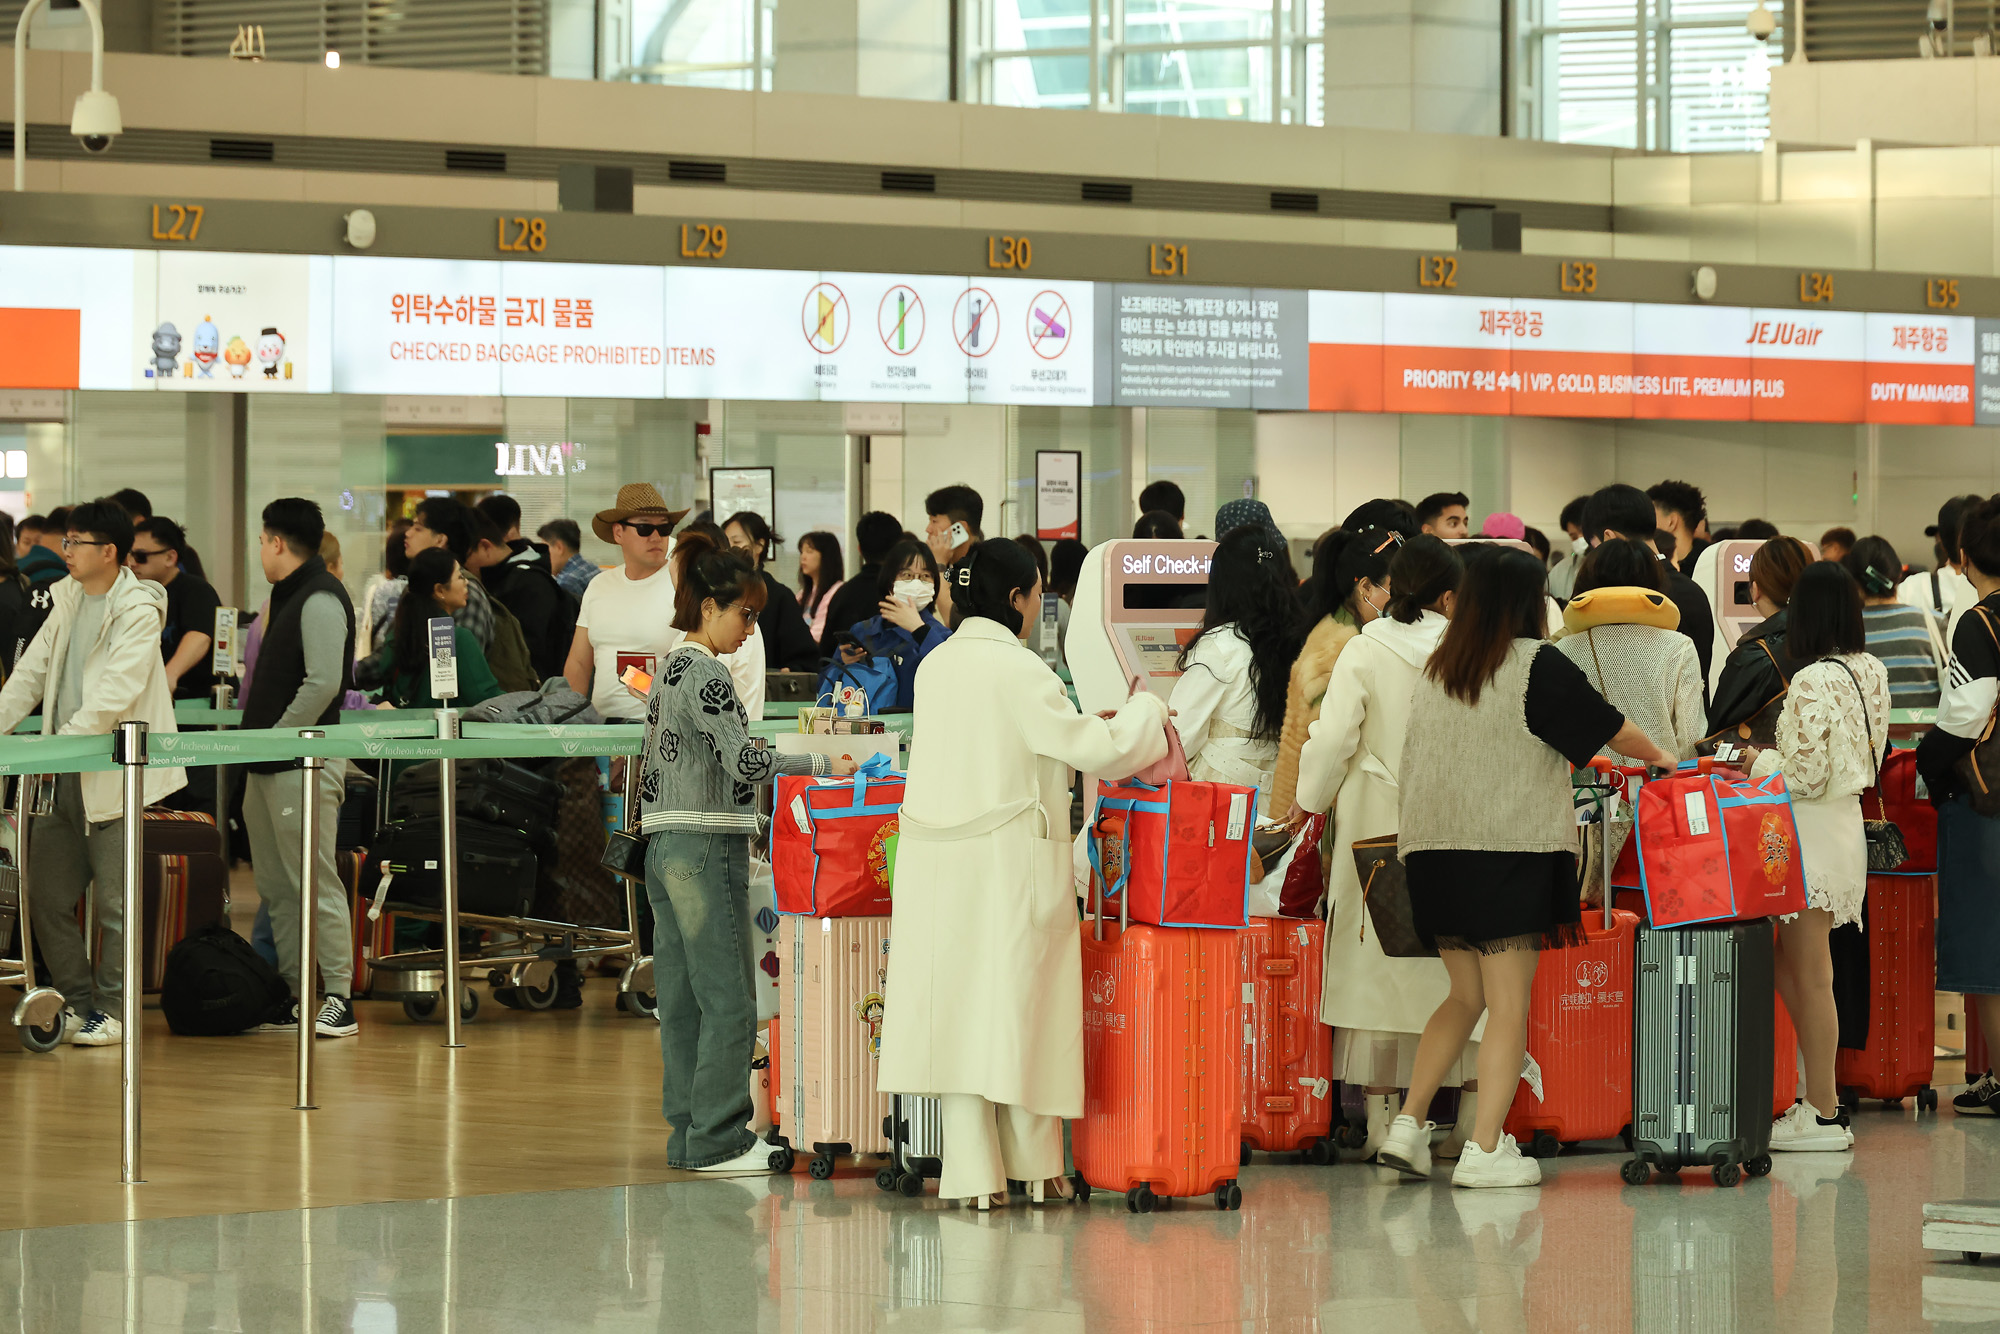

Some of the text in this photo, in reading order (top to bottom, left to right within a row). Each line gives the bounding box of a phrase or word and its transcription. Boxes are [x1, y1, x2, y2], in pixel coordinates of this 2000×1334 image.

[152, 203, 205, 241] L27
[498, 216, 547, 252] L28
[681, 223, 728, 259] L29
[988, 235, 1032, 270] L30
[1150, 243, 1189, 276] L31
[1419, 255, 1458, 288] L32
[1561, 261, 1598, 293] L33
[1800, 272, 1835, 303] L34
[1926, 279, 1960, 309] L35
[391, 293, 595, 329] 위탁수하물 금지 물품
[1479, 309, 1544, 338] 제주항공
[1892, 325, 1949, 352] 제주항공
[390, 341, 716, 367] CHECKED BAGGAGE PROHIBITED ITEMS
[1403, 368, 1471, 390] PRIORITY
[1598, 374, 1661, 395] BUSINESS
[1693, 376, 1751, 397] PREMIUM
[1753, 378, 1785, 398] PLUS
[1871, 382, 1906, 402] DUTY
[1906, 383, 1969, 403] MANAGER
[1122, 554, 1153, 575] Self
[172, 755, 197, 766] Airport
[180, 741, 240, 752] Incheon Airport
[385, 746, 443, 756] Incheon Airport
[581, 744, 637, 754] Incheon Airport
